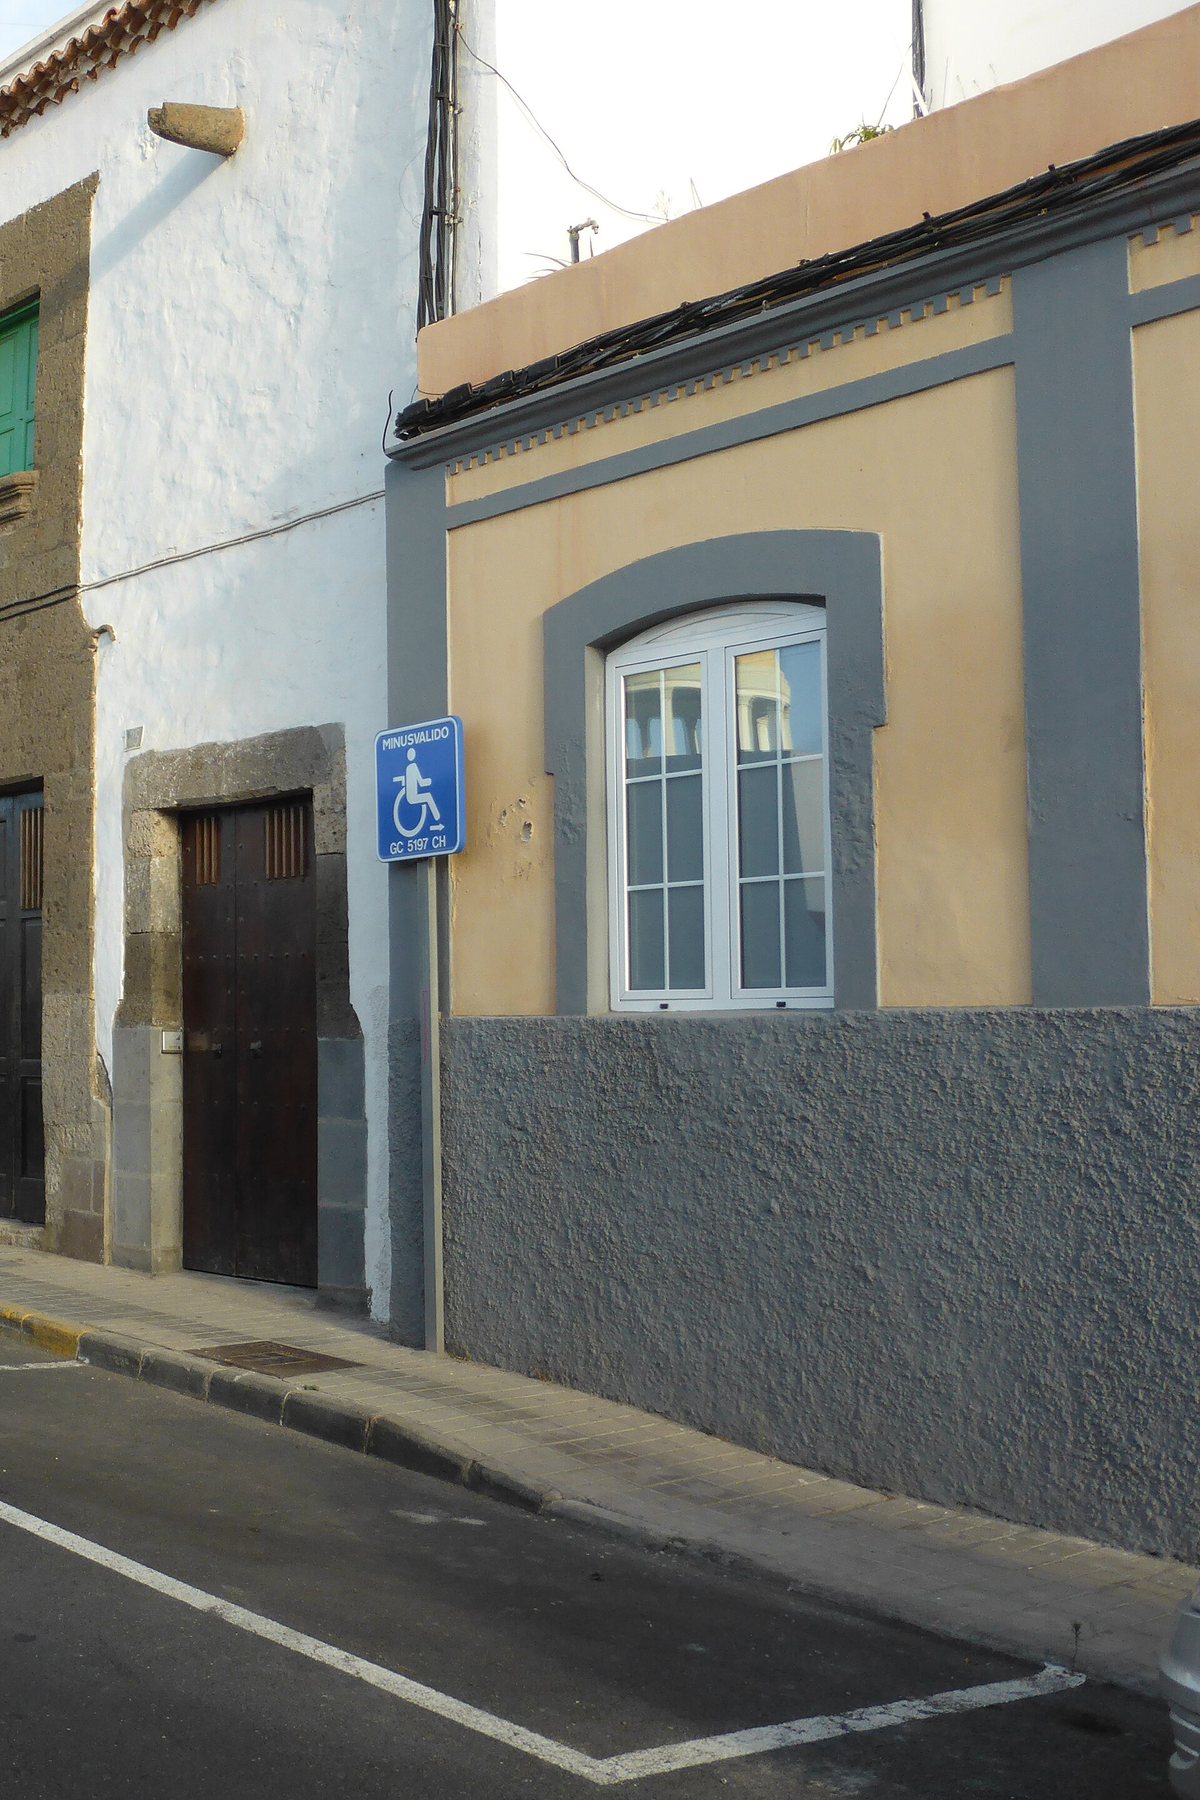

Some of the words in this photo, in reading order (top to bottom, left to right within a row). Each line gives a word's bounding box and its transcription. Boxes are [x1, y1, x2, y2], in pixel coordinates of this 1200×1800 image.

[382, 726, 449, 751] MINUSVALIDO
[390, 841, 403, 854] GC
[407, 837, 429, 852] 5197
[432, 835, 446, 848] CH
